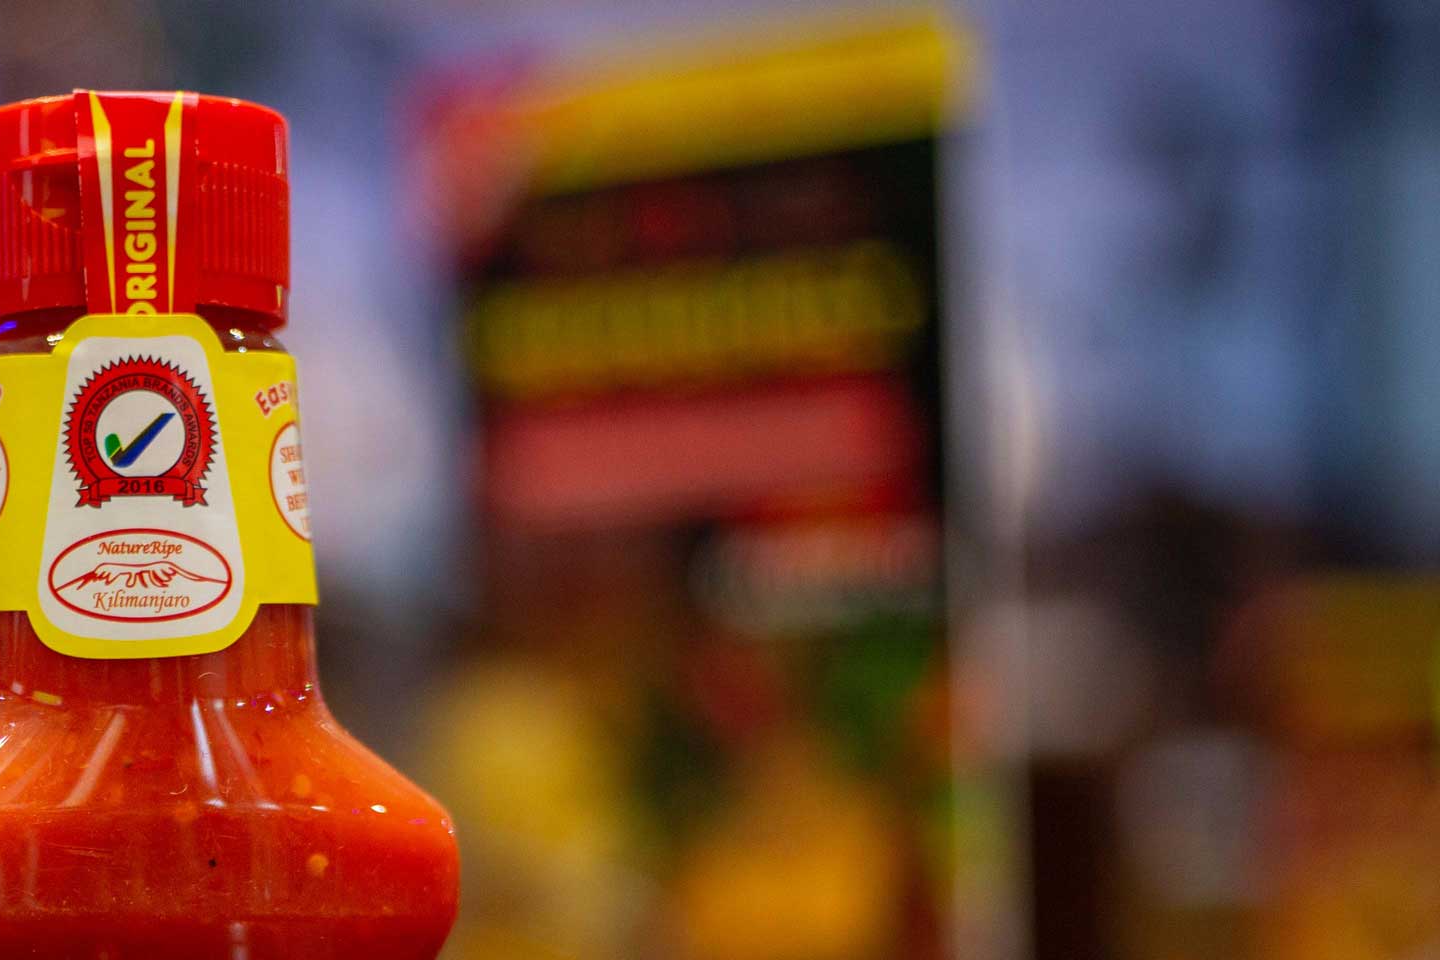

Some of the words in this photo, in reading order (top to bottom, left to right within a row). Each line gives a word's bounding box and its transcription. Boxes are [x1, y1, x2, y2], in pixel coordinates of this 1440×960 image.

[86, 376, 139, 417] TANZANIA
[143, 377, 189, 412] BRANDS
[83, 437, 96, 462] TOP
[118, 479, 165, 493] 2016
[97, 541, 183, 558] NatureRipe
[92, 588, 191, 614] Kilimanjaro
